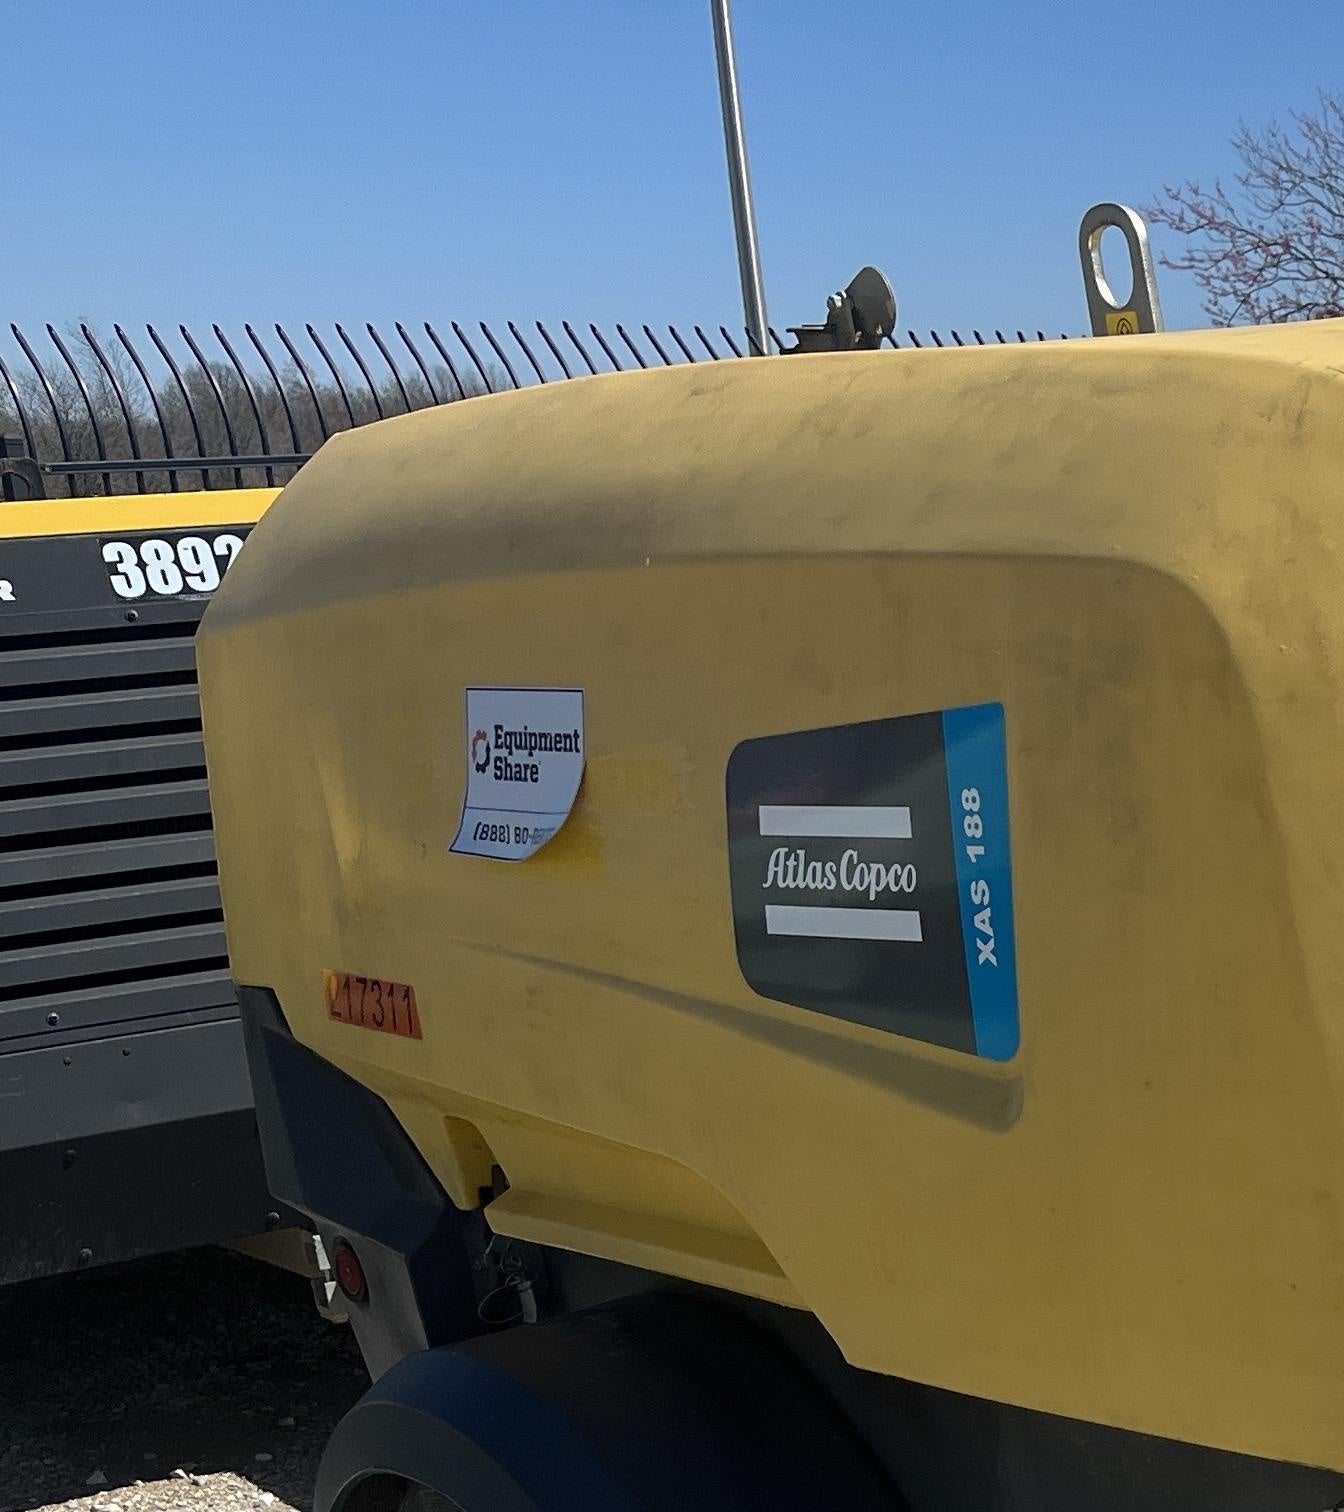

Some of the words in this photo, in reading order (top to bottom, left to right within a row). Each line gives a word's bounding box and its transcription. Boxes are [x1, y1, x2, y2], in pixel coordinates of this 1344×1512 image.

[494, 724, 581, 757] Equipment
[494, 755, 540, 783] Share
[473, 821, 510, 845] (888)
[961, 786, 985, 864] 188
[762, 847, 837, 890] Atlas
[840, 848, 917, 901] Copco
[970, 879, 998, 967] XAS
